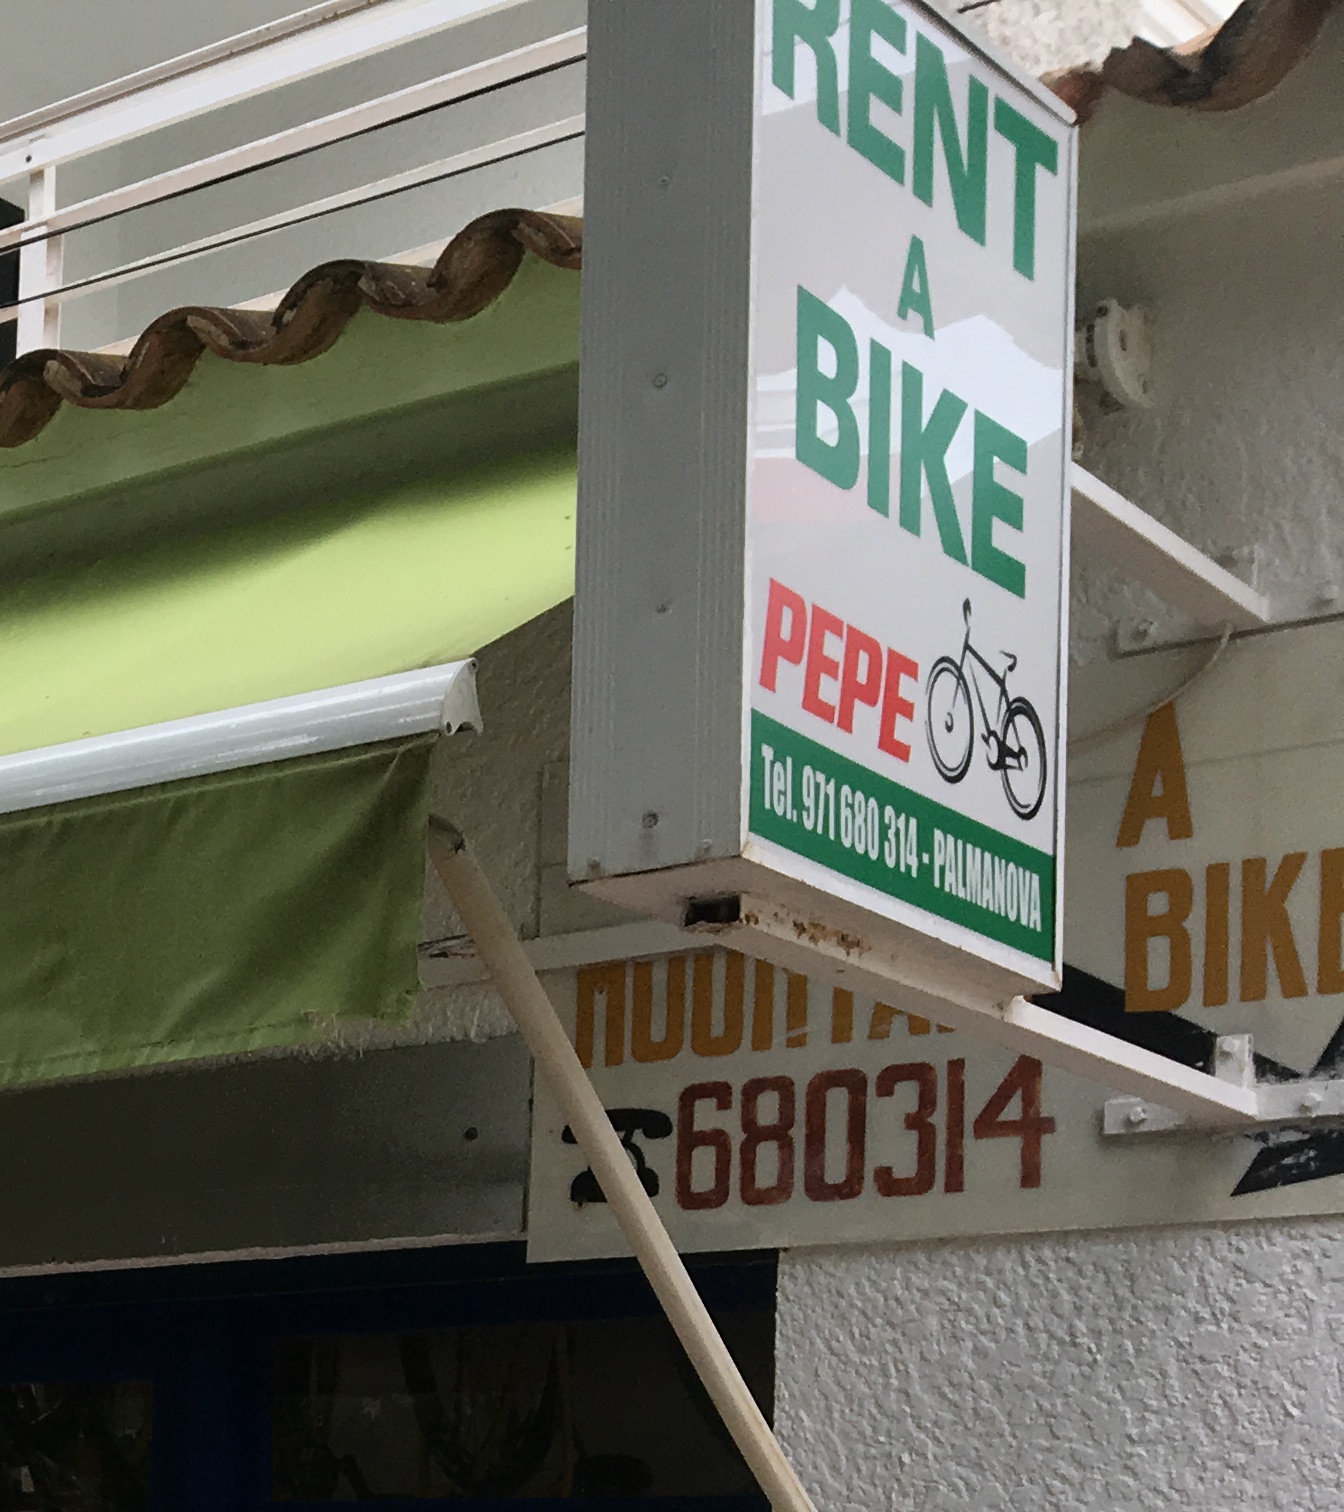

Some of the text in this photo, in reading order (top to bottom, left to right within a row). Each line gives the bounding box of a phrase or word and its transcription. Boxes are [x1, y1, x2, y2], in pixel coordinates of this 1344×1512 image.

[771, 0, 1059, 283] RENT
[897, 234, 935, 341] A
[795, 284, 1028, 600] BIKE
[759, 577, 919, 763] PEPE
[761, 743, 797, 823] Tel.
[802, 764, 836, 841] 971
[840, 784, 880, 861] 680
[884, 805, 919, 878] 314
[933, 827, 1043, 932] PALMANOVA
[1116, 700, 1194, 848] A
[576, 952, 955, 1068] MOUN
[674, 1056, 1056, 1211] 680314
